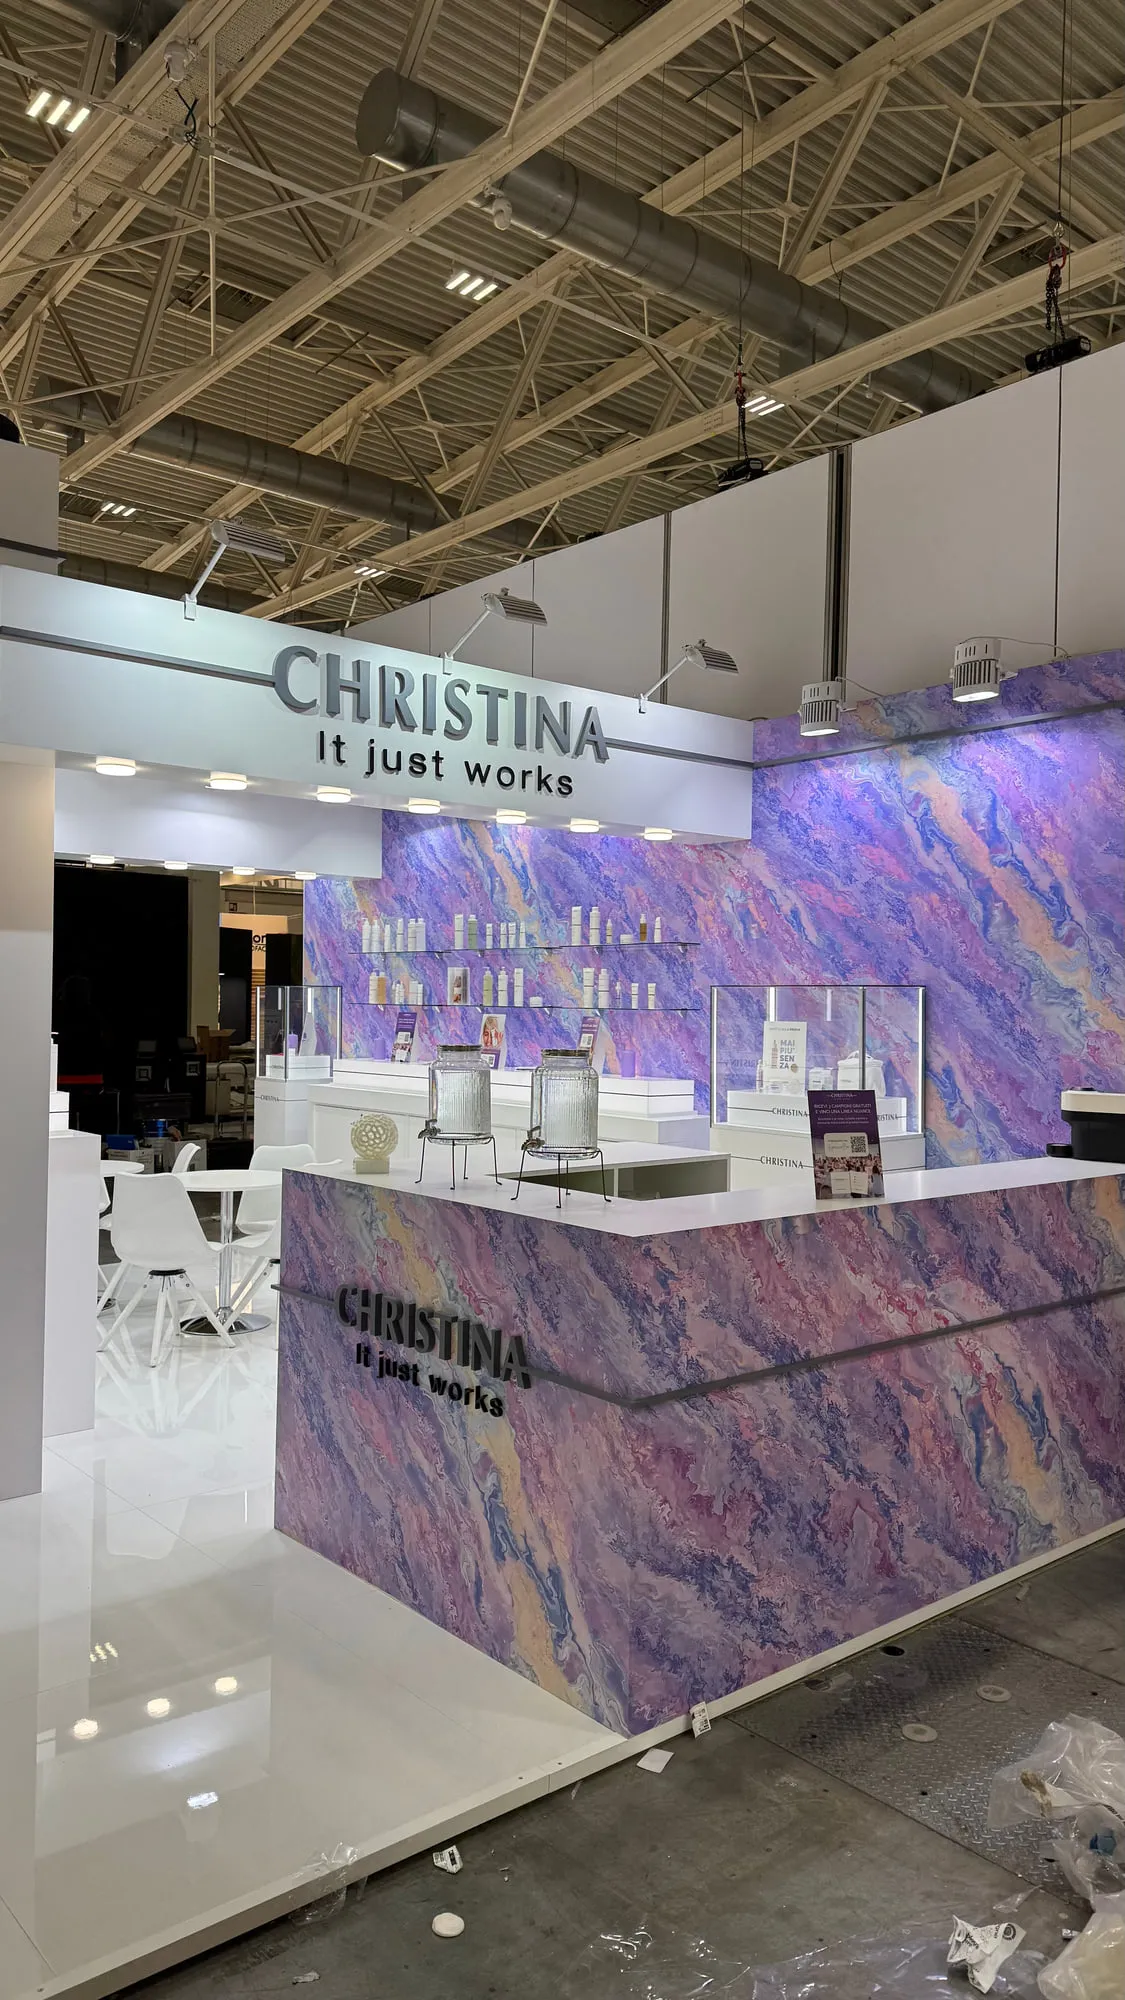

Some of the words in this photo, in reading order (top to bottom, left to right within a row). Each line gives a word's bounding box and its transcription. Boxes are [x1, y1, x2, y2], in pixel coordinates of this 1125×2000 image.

[272, 645, 610, 764] CHRISTINA
[317, 730, 346, 765] It
[364, 738, 445, 778] just
[463, 760, 574, 797] works
[780, 1039, 796, 1047] MAI
[779, 1062, 790, 1070] ZA
[771, 1107, 808, 1118] CHRISTINA
[759, 1155, 804, 1170] CHRISTINA
[336, 1284, 531, 1390] CHRISTINA
[355, 1342, 371, 1368] It
[376, 1350, 421, 1388] just
[428, 1373, 505, 1419] works
